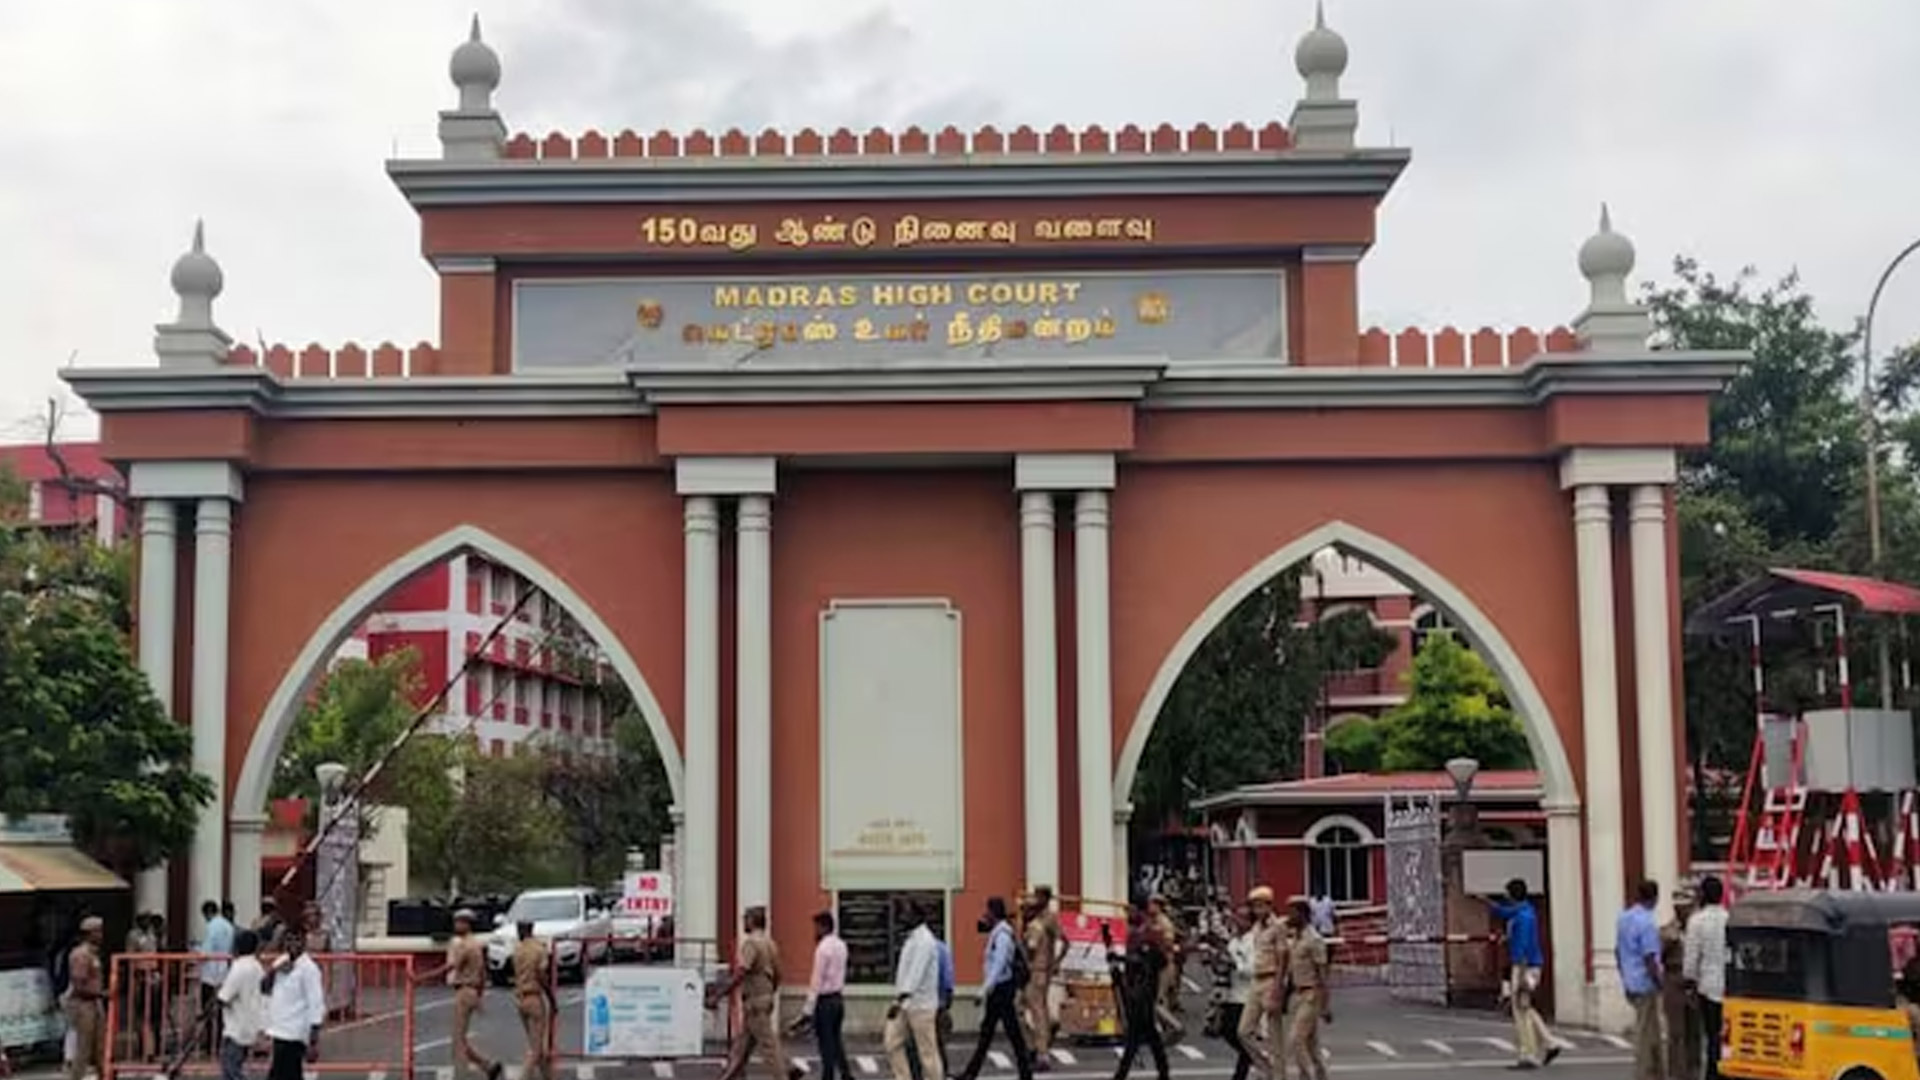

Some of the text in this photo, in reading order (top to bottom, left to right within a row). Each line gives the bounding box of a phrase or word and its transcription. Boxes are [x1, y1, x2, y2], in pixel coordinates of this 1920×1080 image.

[642, 214, 1152, 249] 150வது ஆண்டு நினைவு வளைவு
[714, 282, 1081, 307] MADRAS HIGH COURT
[638, 876, 659, 891] NO
[626, 896, 669, 911] ENTRY
